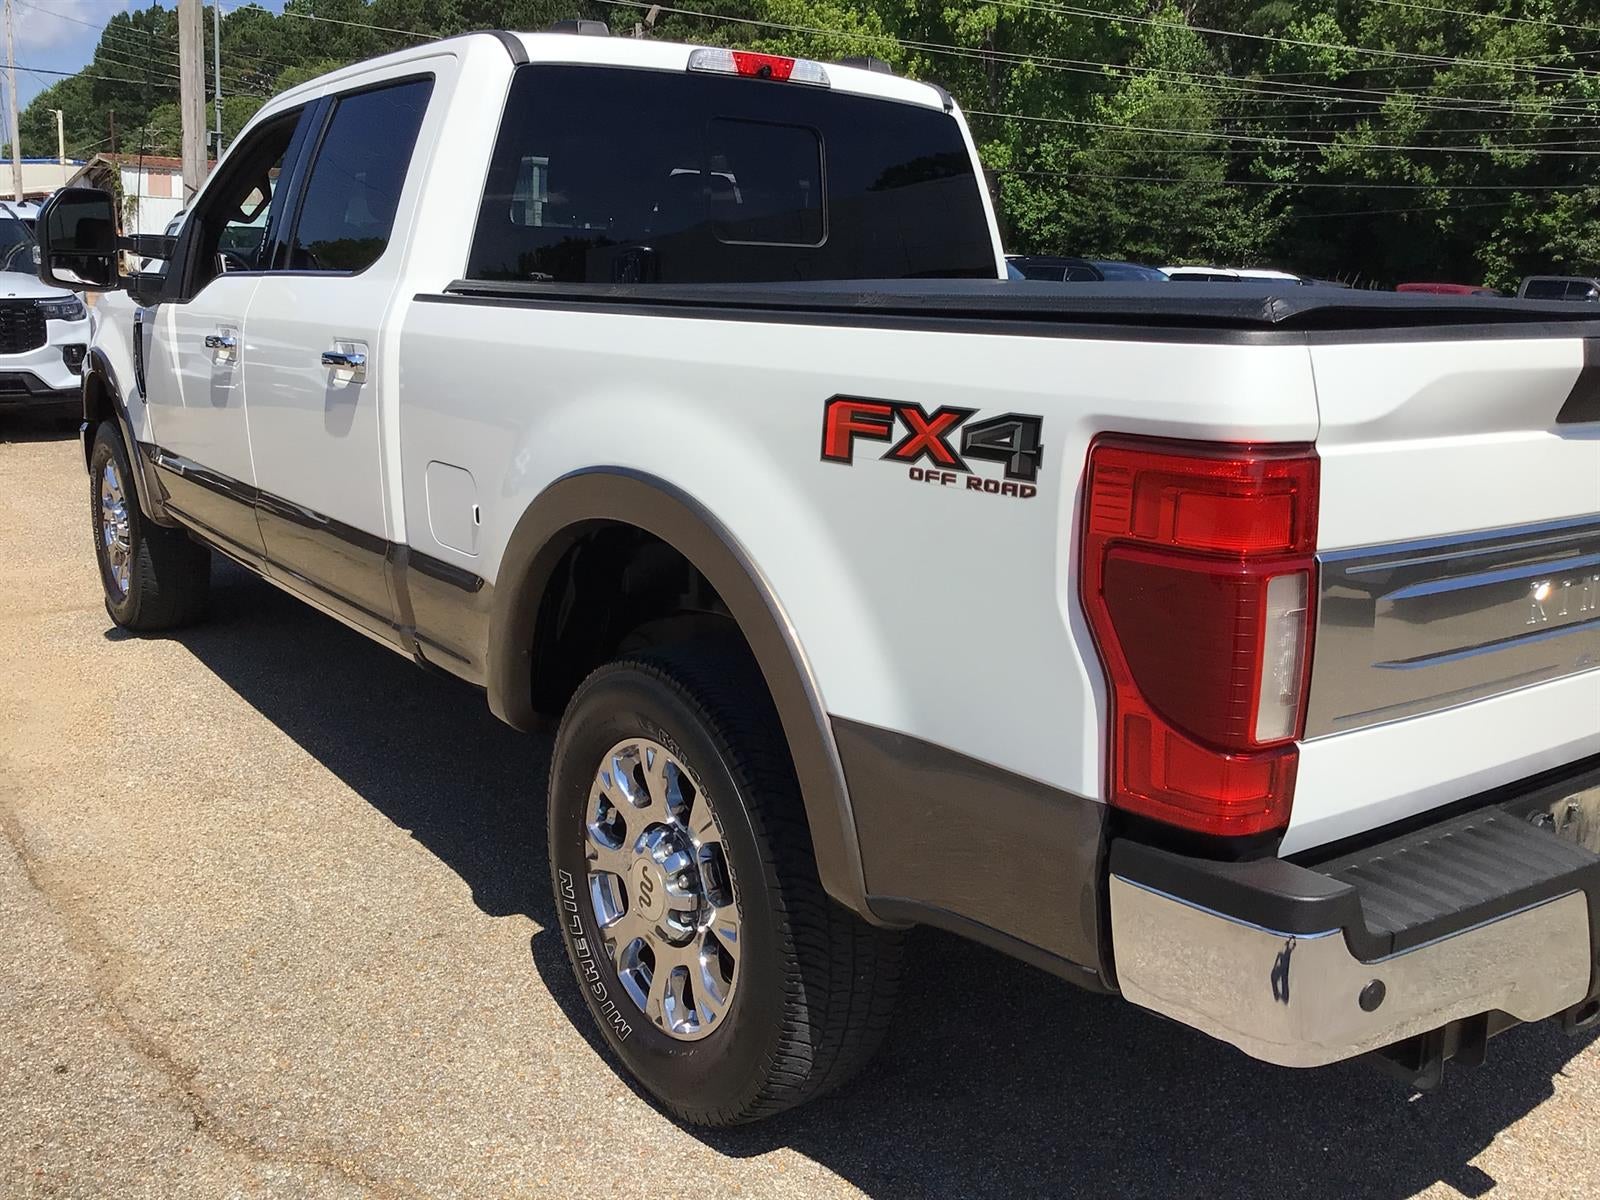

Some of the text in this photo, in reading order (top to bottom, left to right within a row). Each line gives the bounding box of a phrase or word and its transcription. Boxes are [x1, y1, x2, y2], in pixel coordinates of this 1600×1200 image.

[820, 393, 1044, 484] FX4
[909, 466, 1037, 499] OFF ROAD
[558, 868, 633, 1042] MICHELIN
